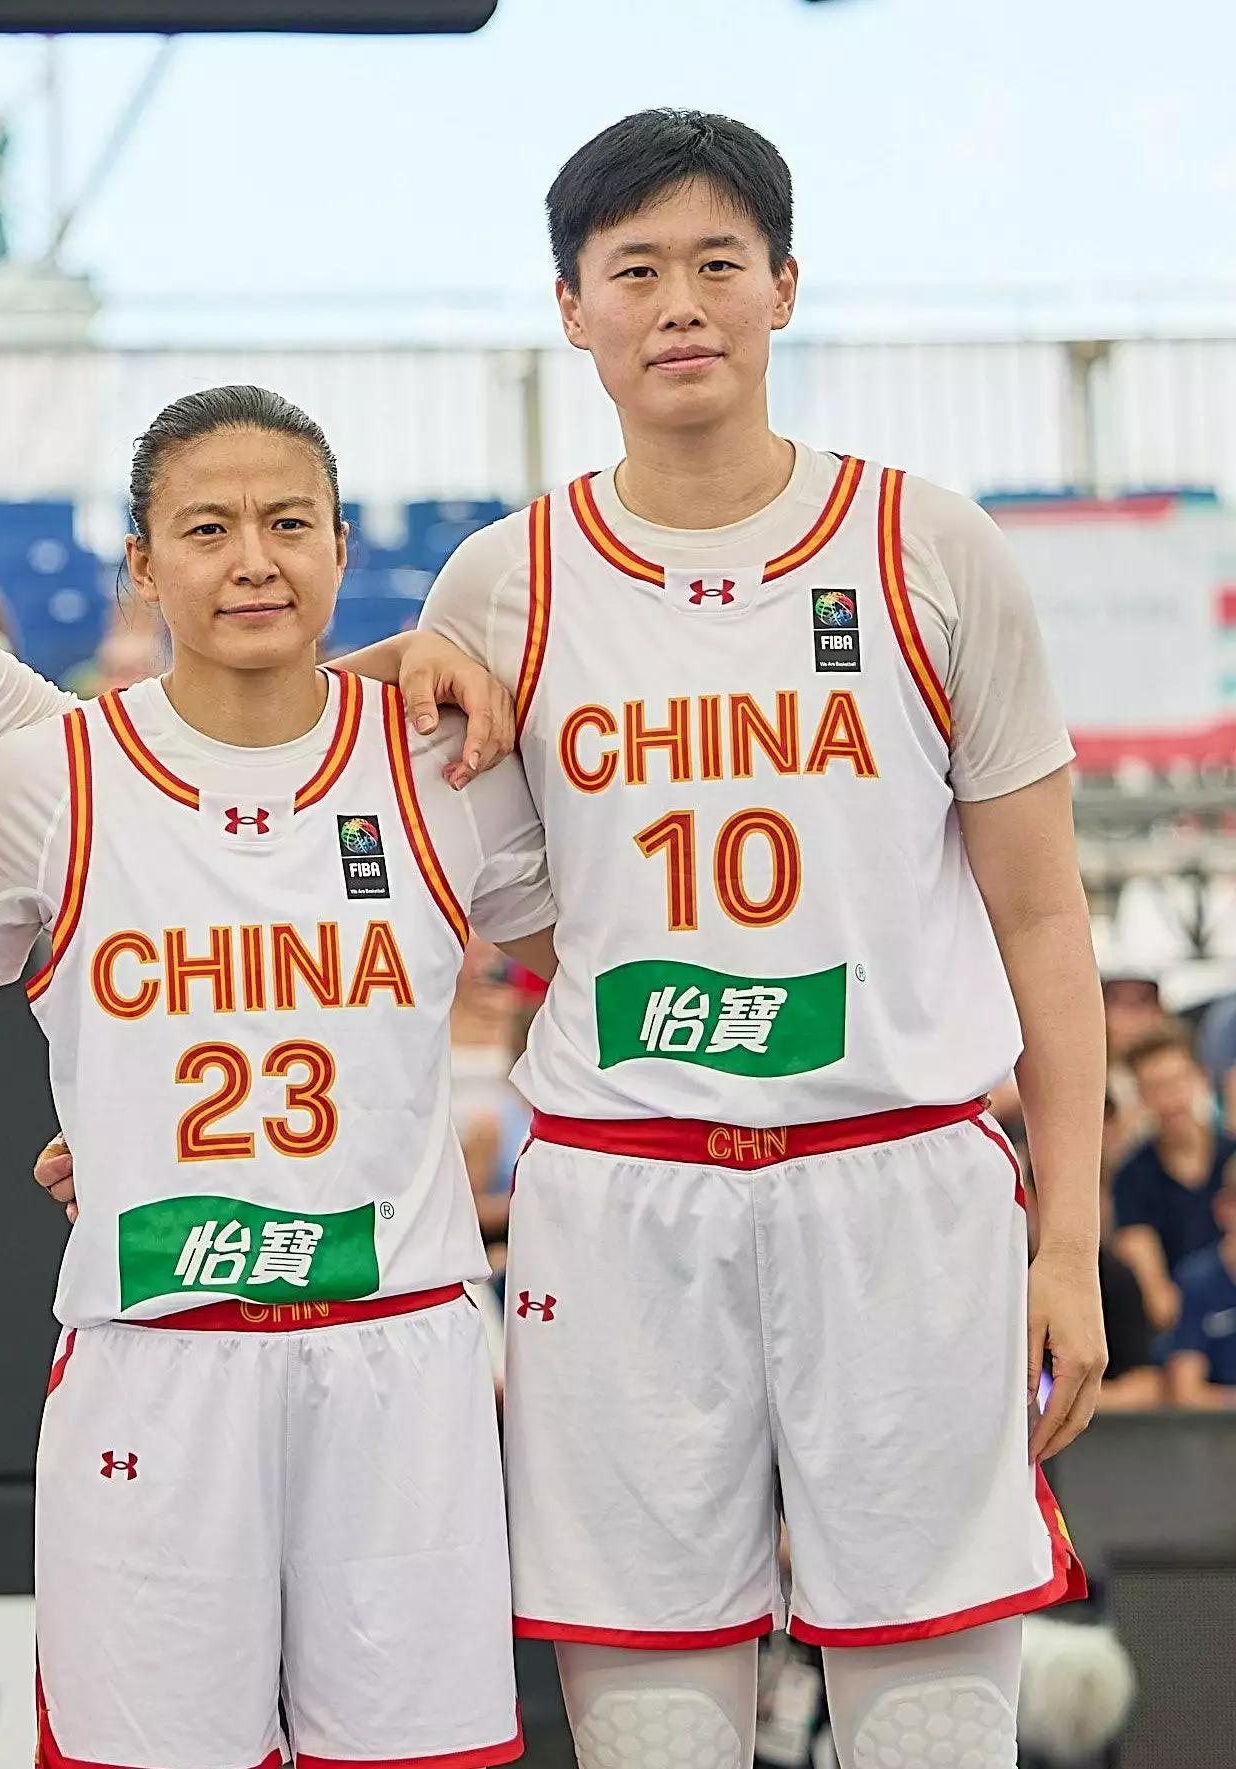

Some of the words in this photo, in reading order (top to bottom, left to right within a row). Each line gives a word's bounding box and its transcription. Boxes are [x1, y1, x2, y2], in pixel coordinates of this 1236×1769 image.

[821, 634, 853, 650] FIBA
[559, 690, 879, 794] CHINA
[348, 861, 381, 878] FIBA
[633, 808, 801, 931] 10
[91, 920, 415, 1020] CHINA
[639, 985, 787, 1053] 怡寶
[175, 1039, 338, 1163] 23
[707, 1127, 787, 1161] CHN
[174, 1219, 324, 1287] 怡寶
